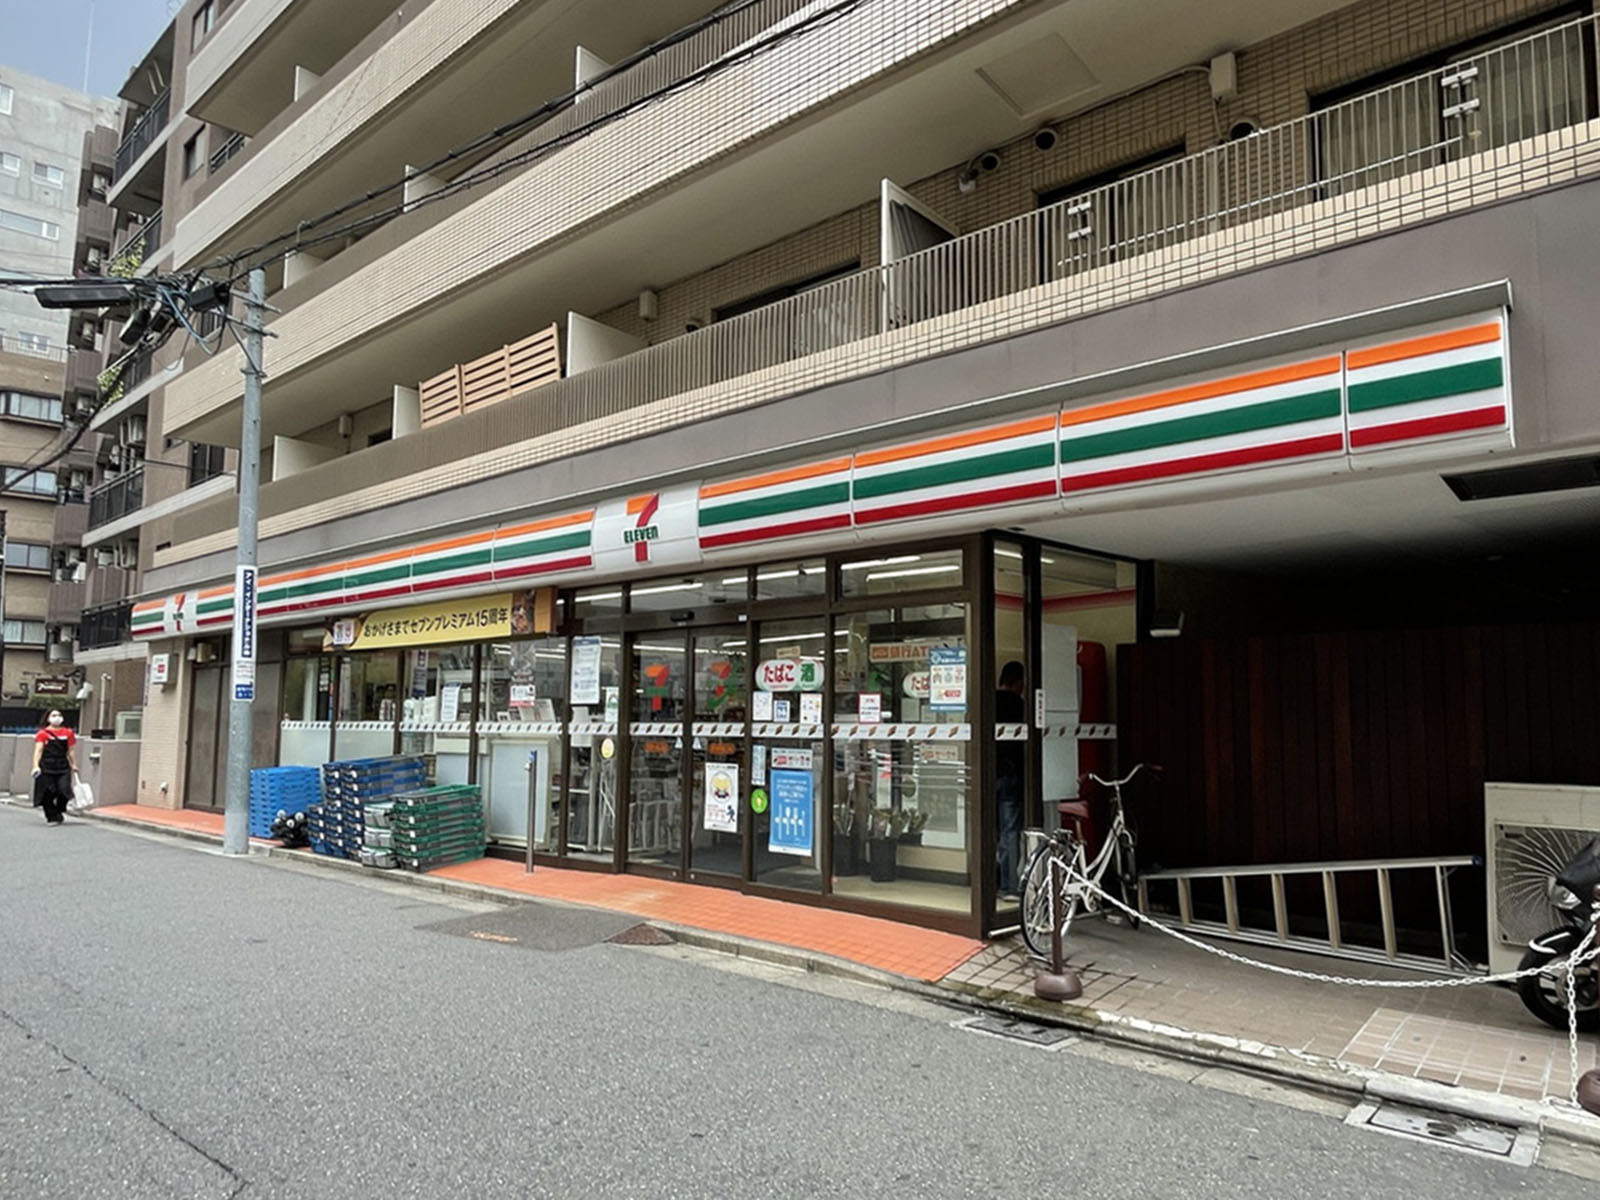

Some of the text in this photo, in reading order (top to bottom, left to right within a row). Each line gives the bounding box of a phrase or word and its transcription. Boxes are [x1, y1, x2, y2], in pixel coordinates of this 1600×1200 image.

[626, 493, 660, 563] 7
[363, 607, 508, 638] おかげさまでセブンプレミアム15周年
[764, 663, 815, 682] たばこ 酒
